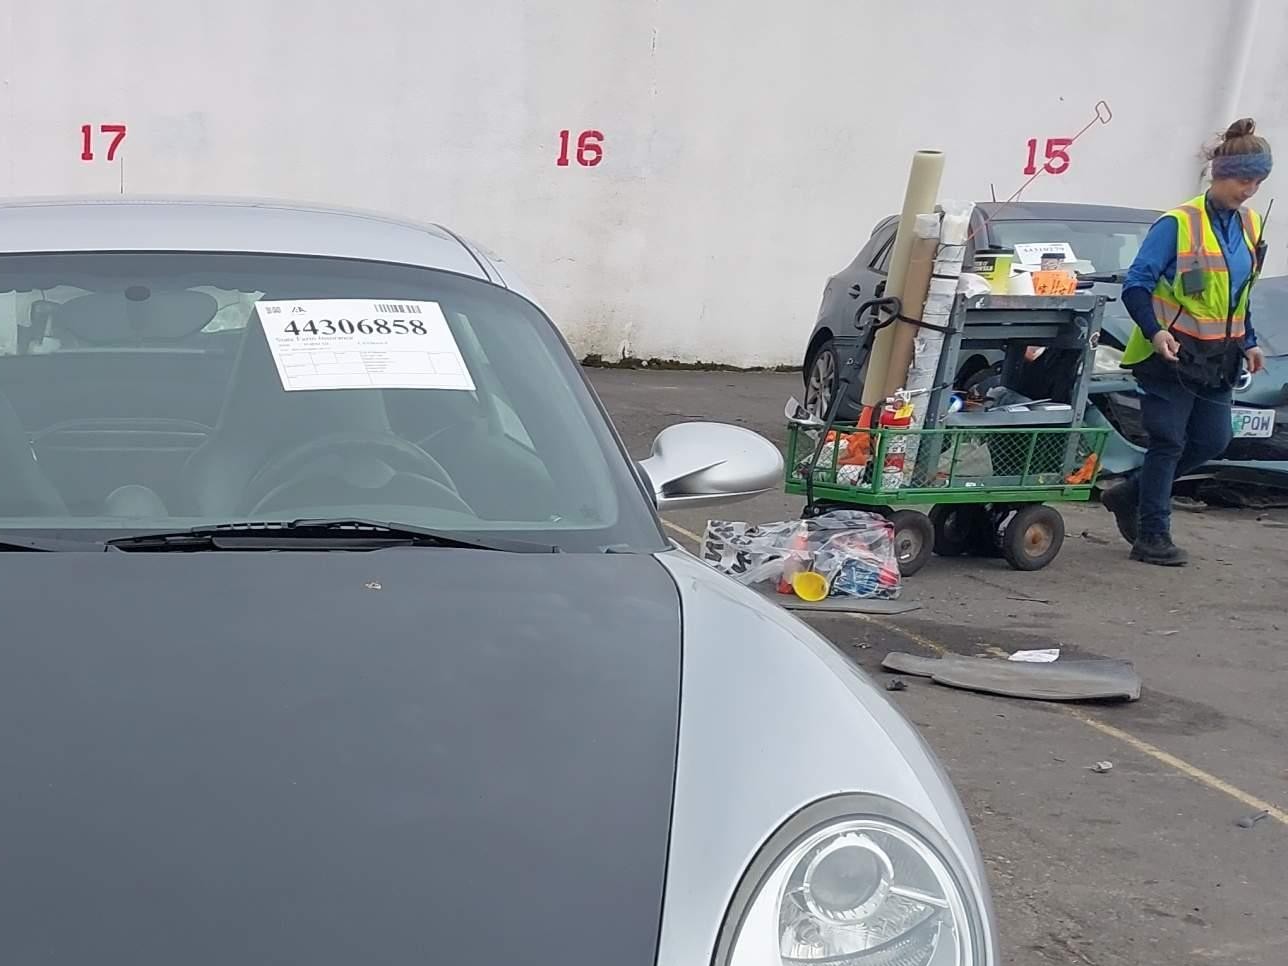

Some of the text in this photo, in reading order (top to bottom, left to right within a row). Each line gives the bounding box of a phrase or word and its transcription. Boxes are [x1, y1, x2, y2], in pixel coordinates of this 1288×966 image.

[81, 124, 126, 161] 17
[557, 131, 603, 166] 16
[1024, 138, 1072, 175] 15
[283, 318, 428, 336] 44306858
